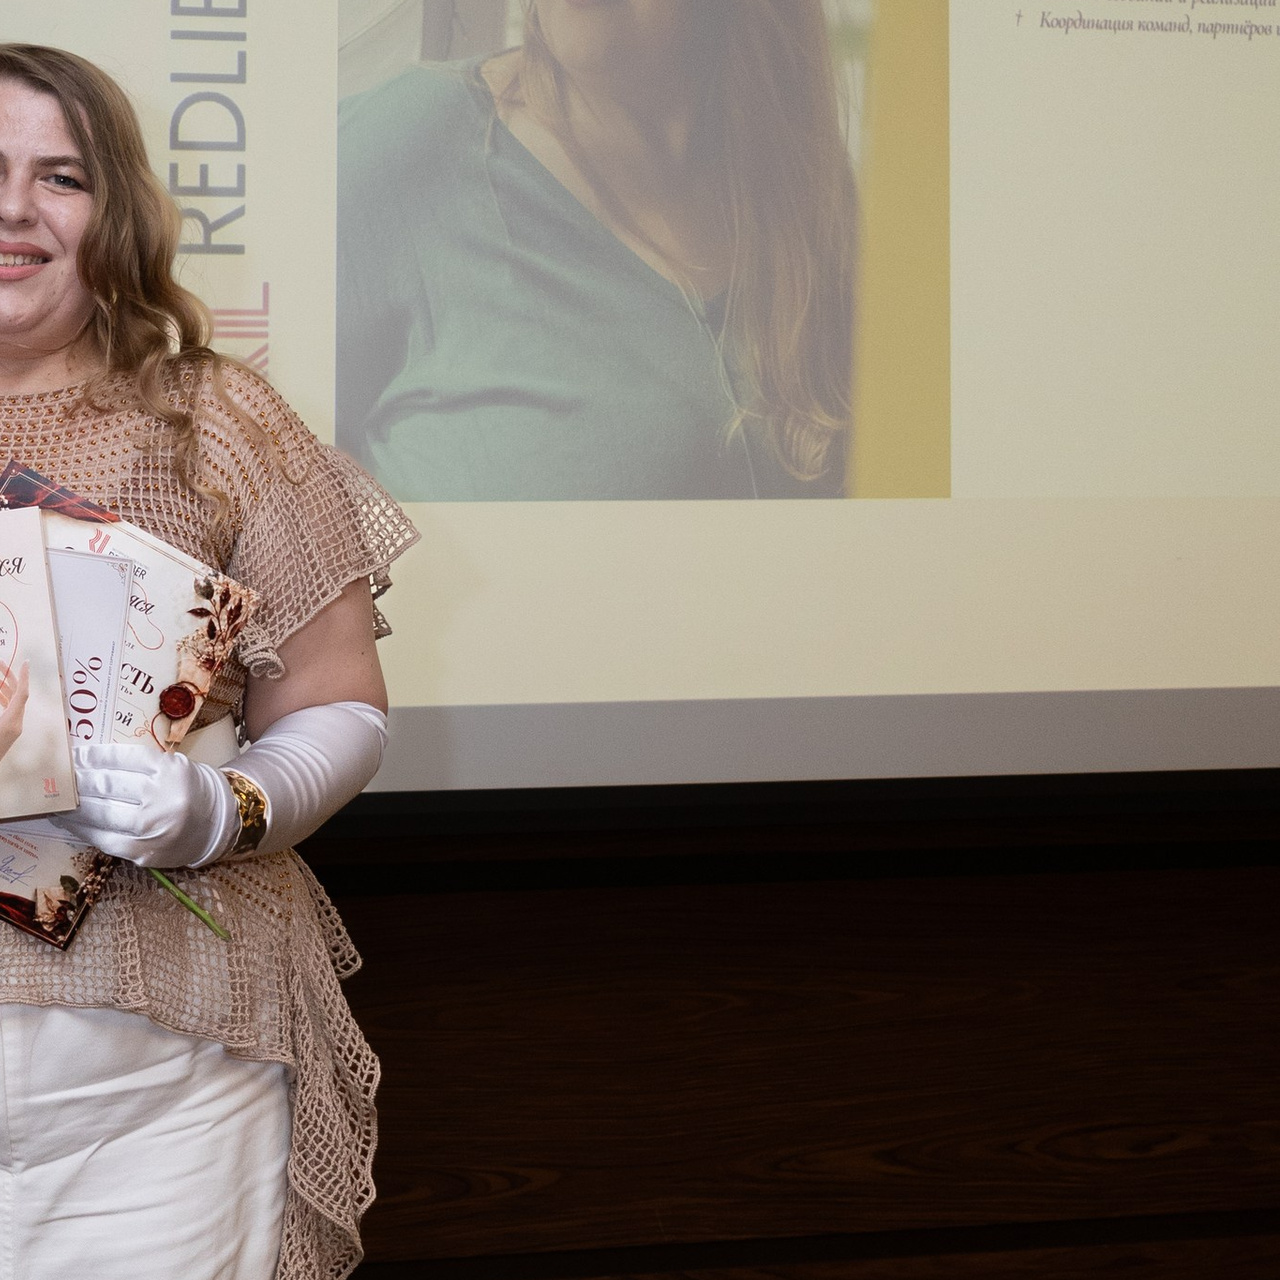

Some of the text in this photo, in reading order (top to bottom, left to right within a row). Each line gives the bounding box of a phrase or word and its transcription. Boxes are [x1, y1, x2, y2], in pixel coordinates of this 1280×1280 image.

[1039, 11, 1135, 35] Координация
[1137, 14, 1194, 35] команд,
[1197, 20, 1273, 41] партнёров
[67, 656, 104, 741] 50%
